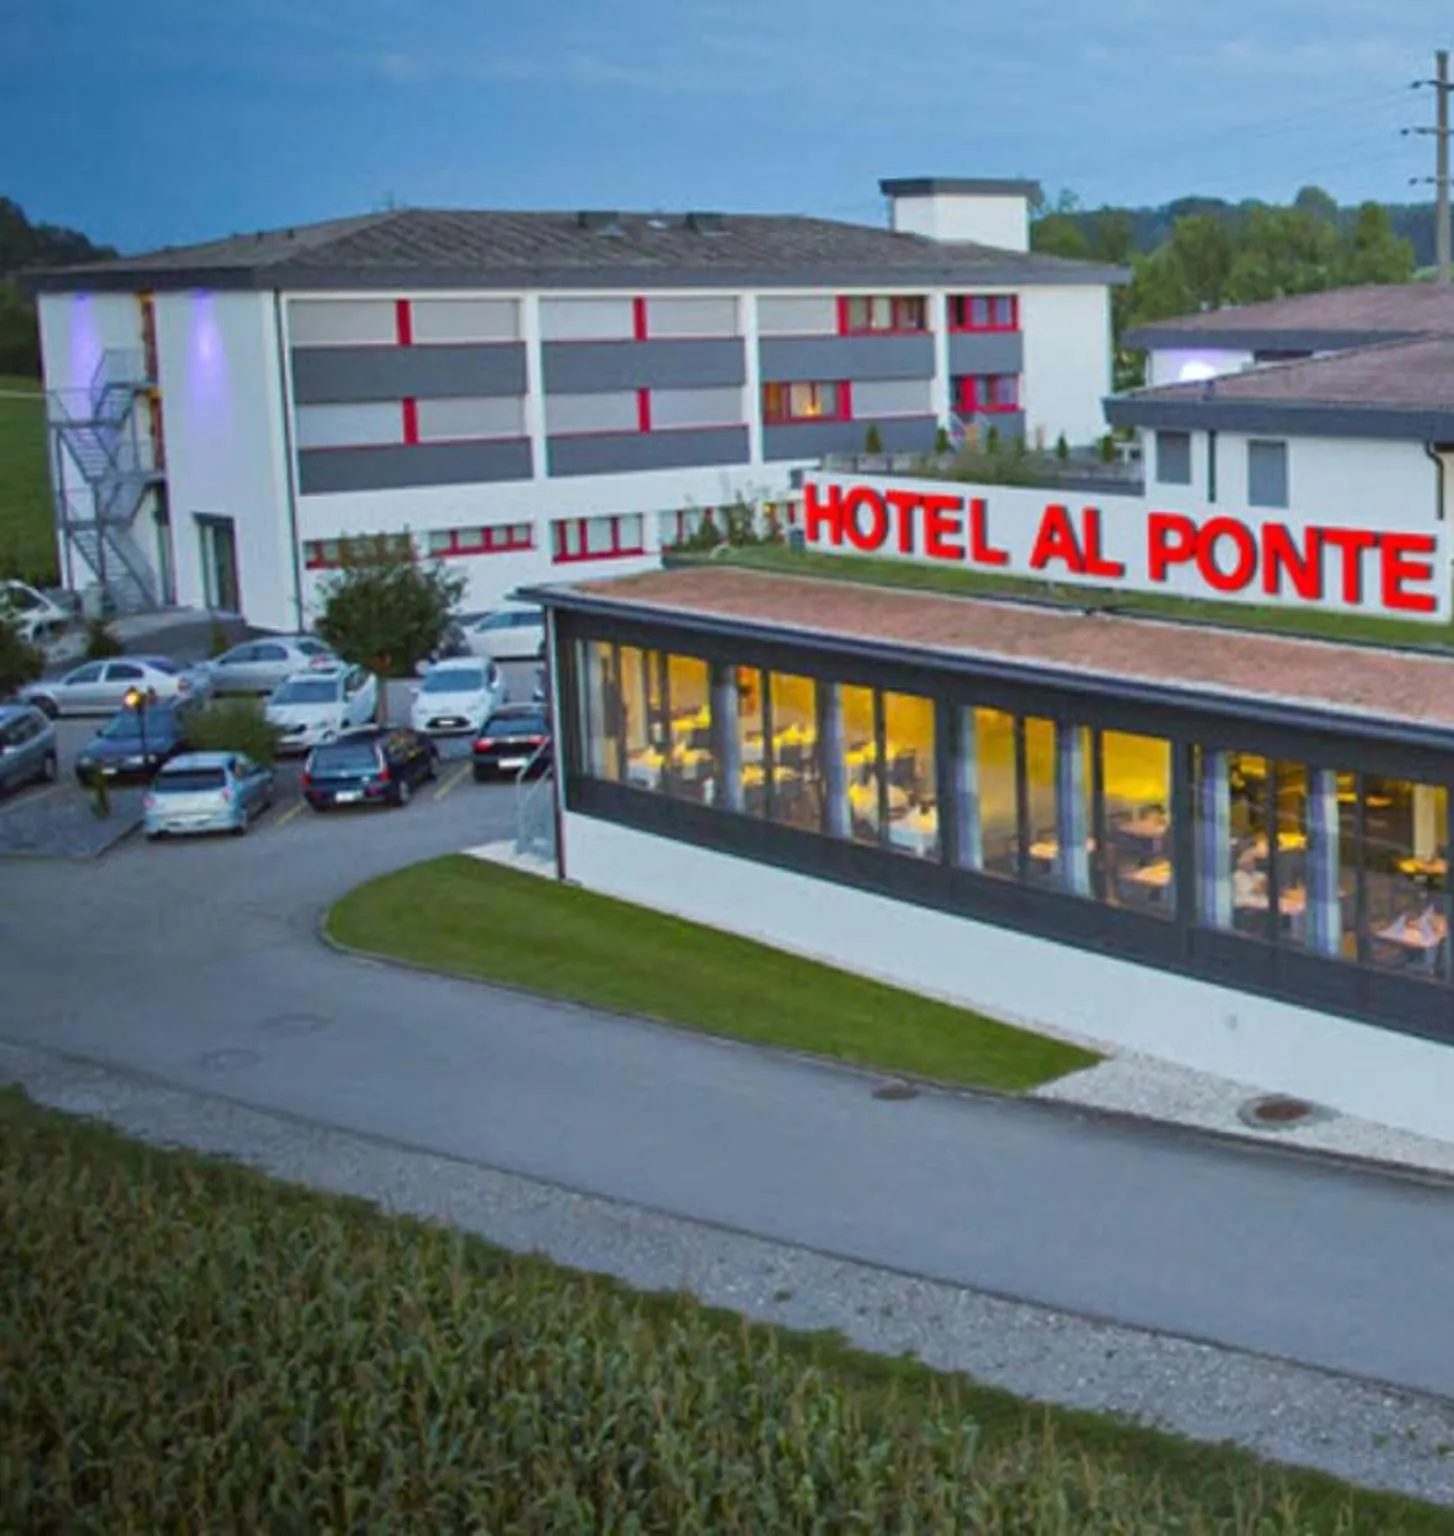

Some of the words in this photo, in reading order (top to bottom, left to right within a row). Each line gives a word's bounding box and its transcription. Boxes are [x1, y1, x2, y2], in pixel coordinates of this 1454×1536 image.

[803, 482, 1009, 567] HOTEL
[1029, 503, 1124, 579] AL
[1147, 511, 1437, 614] PONTE
